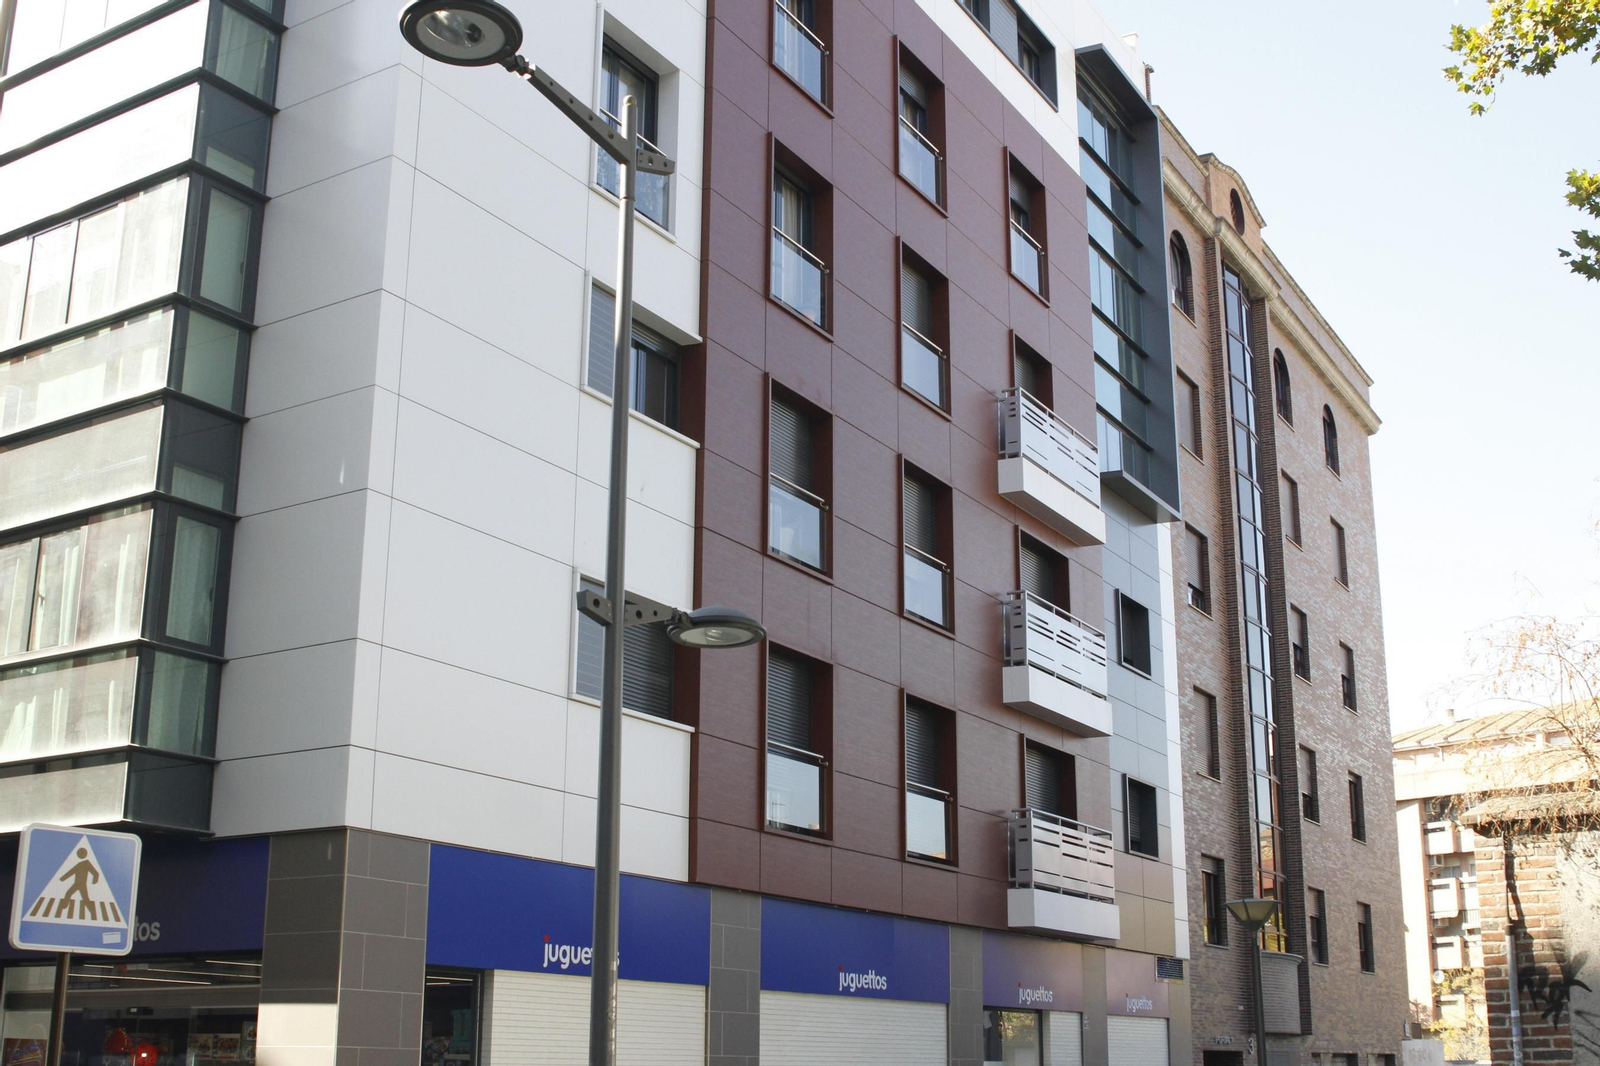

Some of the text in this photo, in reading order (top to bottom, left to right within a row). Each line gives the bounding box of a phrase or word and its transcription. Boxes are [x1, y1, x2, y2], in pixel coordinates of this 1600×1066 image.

[543, 934, 620, 970] jugue
[838, 966, 888, 993] juguettos
[1018, 982, 1054, 1006] juguettos
[1248, 1037, 1255, 1054] 3
